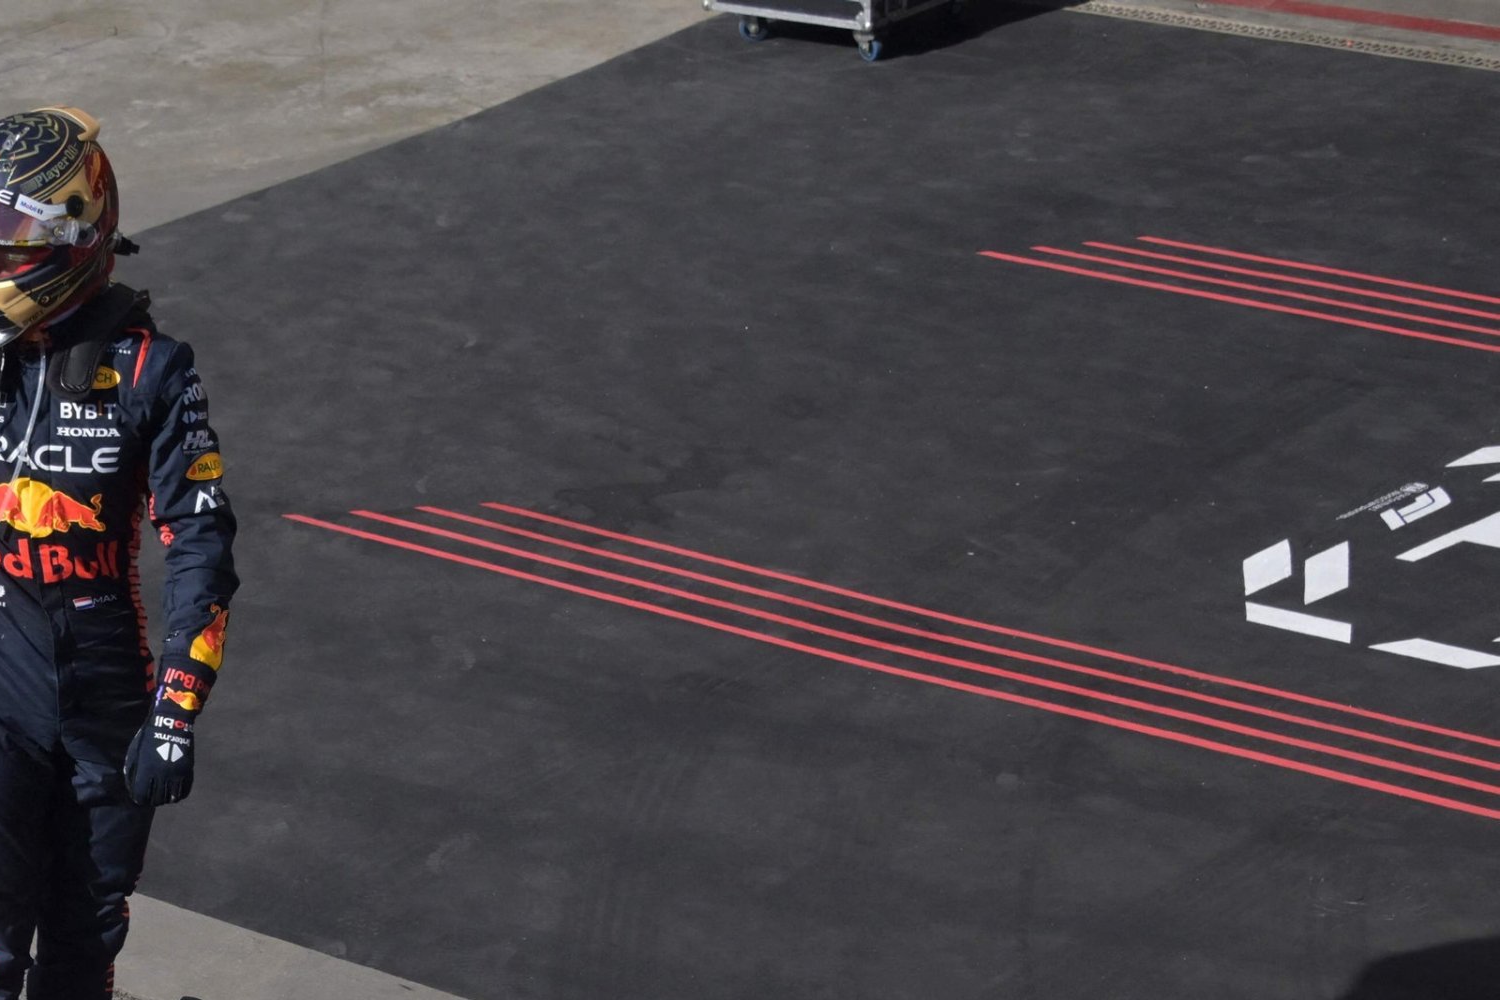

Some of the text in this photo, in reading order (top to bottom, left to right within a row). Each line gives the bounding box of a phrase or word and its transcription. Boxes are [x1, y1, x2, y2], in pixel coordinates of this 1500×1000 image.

[60, 402, 116, 420] BYBIT
[56, 426, 121, 438] HONDA
[38, 541, 119, 584] Bull
